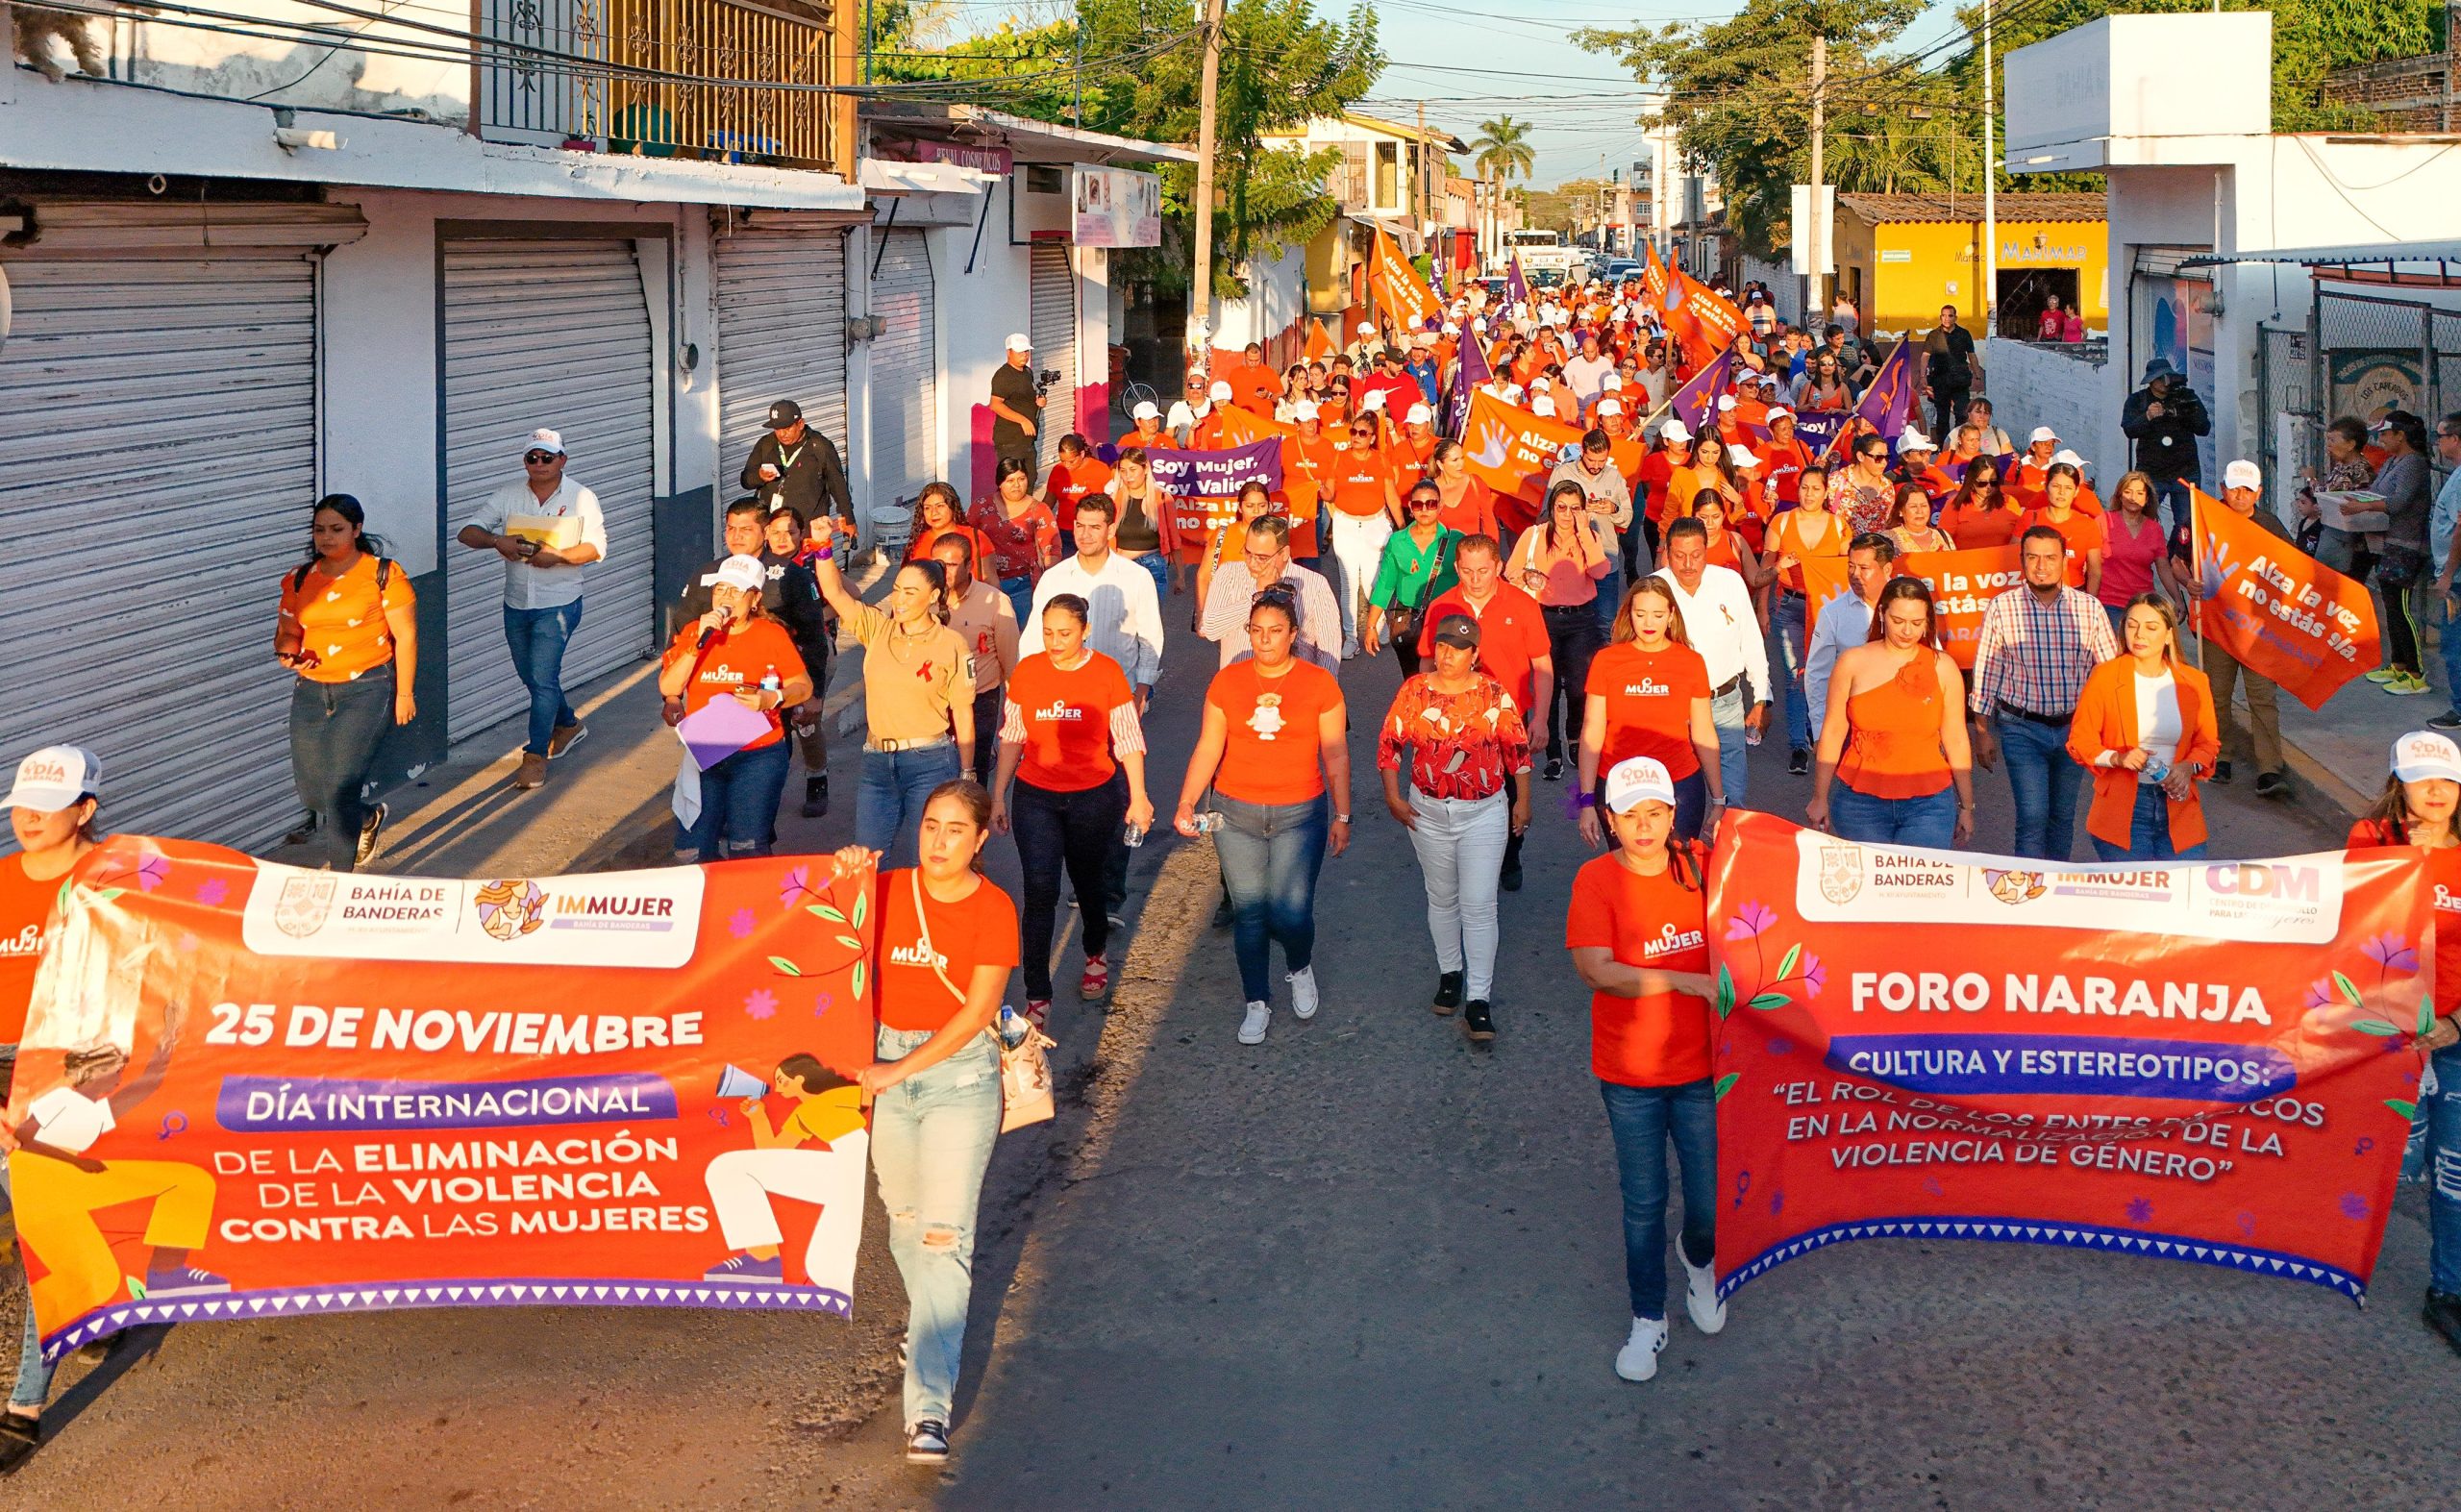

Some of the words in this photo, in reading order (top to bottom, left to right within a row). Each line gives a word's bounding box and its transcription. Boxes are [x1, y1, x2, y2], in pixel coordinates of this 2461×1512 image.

[2001, 241, 2087, 262] MARIMAR
[2360, 387, 2374, 401] LOS
[1520, 431, 1558, 454] Alza
[1517, 447, 1540, 464] no
[1153, 459, 1191, 478] Soy
[1196, 456, 1258, 477] Mujer,
[1175, 498, 1221, 513] Alza
[1176, 516, 1202, 530] no
[1943, 572, 1970, 592] la
[2248, 555, 2296, 595] Alza
[2297, 585, 2323, 609] la
[2237, 578, 2266, 607] no
[2269, 598, 2326, 639] estás
[700, 669, 743, 682] MUJER
[1625, 681, 1670, 694] MUJER
[1035, 705, 1082, 718] MUJER
[1875, 873, 1954, 886] BANDERAS
[2206, 863, 2320, 902] CDM
[351, 882, 413, 903] BAHÍA
[419, 886, 446, 903] DE
[343, 905, 444, 921] BANDERAS
[556, 894, 674, 916] IMMUJER
[2209, 908, 2232, 919] PARA
[1644, 927, 1703, 955] MUJER
[1852, 972, 1991, 1012] FORO
[2005, 974, 2272, 1026] NARANJA
[206, 1003, 276, 1046] 25
[285, 1004, 365, 1049] DE
[370, 1009, 705, 1055] NOVIEMBRE
[1849, 1050, 1987, 1078] CULTURA
[1991, 1050, 2015, 1075] Y
[2021, 1050, 2271, 1087] ESTEREOTIPOS:
[246, 1084, 316, 1122] DÍA
[327, 1086, 651, 1121] INTERNACIONAL
[1830, 1081, 1898, 1104] ROL
[1908, 1098, 1960, 1115] DE
[1966, 1109, 2035, 1128] LOS
[2043, 1114, 2151, 1130] ENTES
[1786, 1113, 1829, 1140] EN
[1839, 1110, 1877, 1135] LA
[1887, 1110, 2174, 1142] NORMALIZACIÓN
[2182, 1122, 2232, 1148] DE
[2241, 1128, 2284, 1157] LA
[214, 1151, 276, 1176] DE
[289, 1148, 344, 1174] LA
[355, 1128, 679, 1174] ELIMINACIÓN
[1830, 1140, 2005, 1169] VIOLENCIA
[2014, 1144, 2061, 1165] DE
[259, 1182, 319, 1209] DE
[332, 1180, 386, 1207] LA
[392, 1171, 660, 1204] VIOLENCIA
[219, 1215, 414, 1243] CONTRA
[424, 1211, 499, 1239] LAS
[510, 1204, 710, 1234] MUJERES
